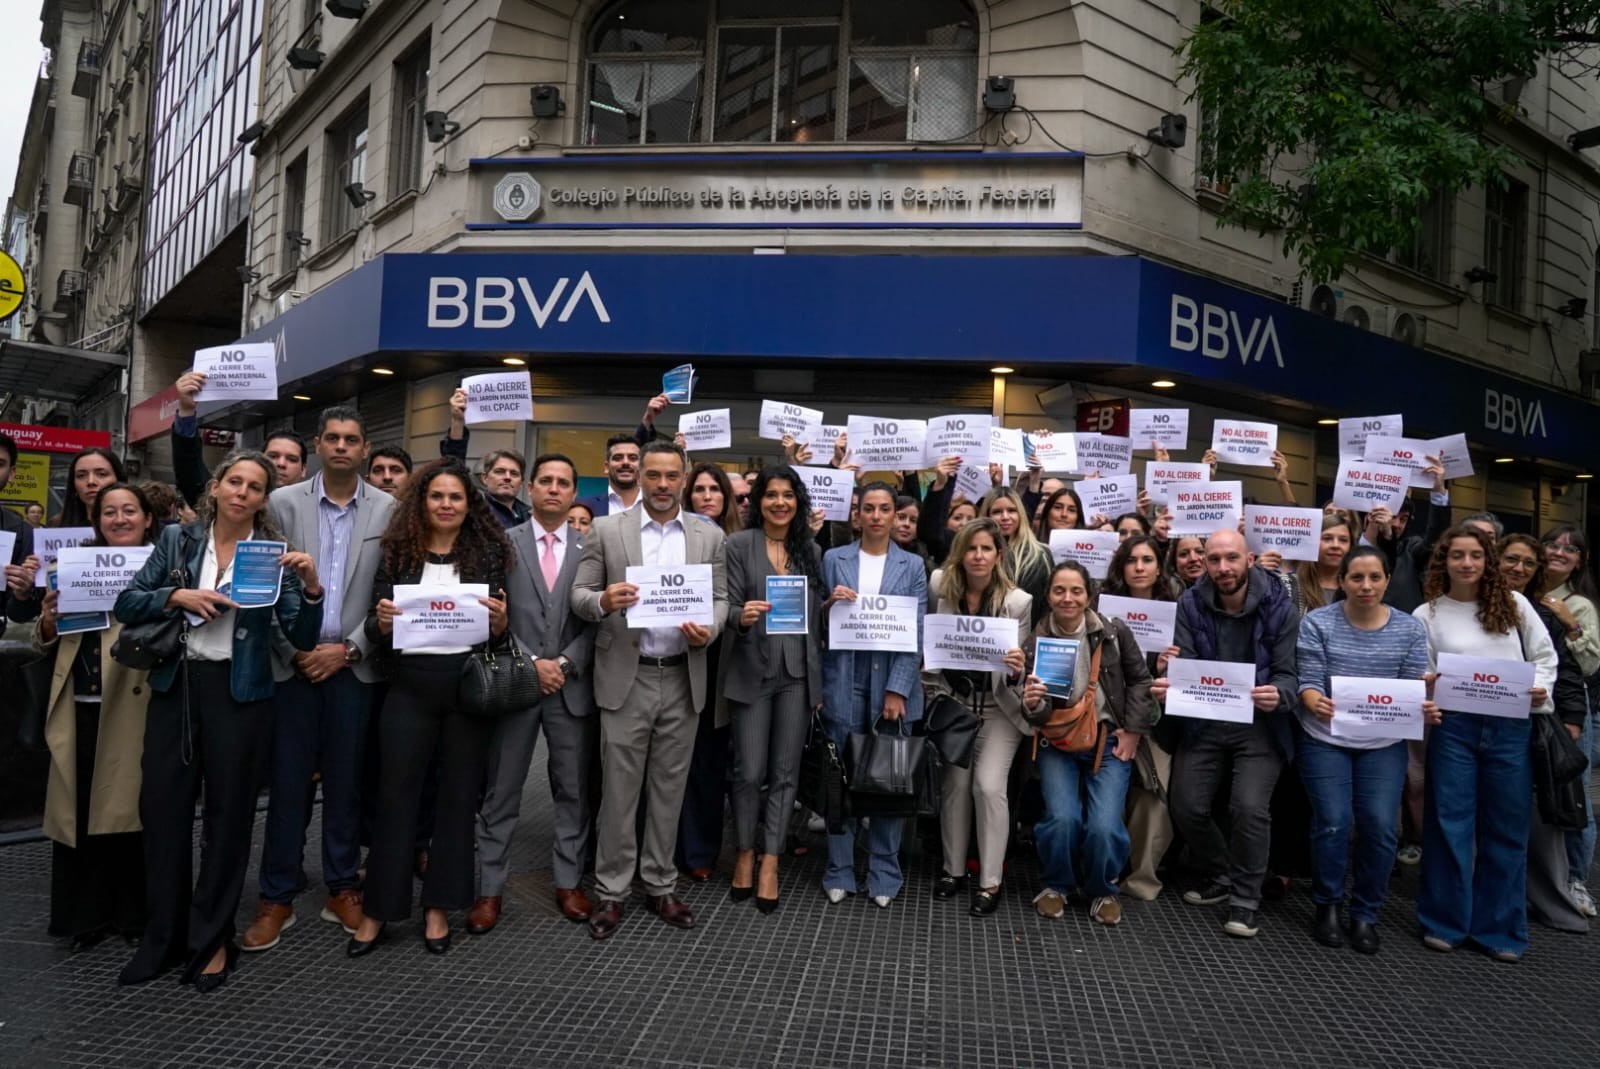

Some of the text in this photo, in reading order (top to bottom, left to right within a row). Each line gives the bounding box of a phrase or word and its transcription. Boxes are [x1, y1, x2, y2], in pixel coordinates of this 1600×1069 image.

[550, 186, 617, 205] Colegio
[623, 185, 693, 204] Público
[700, 186, 722, 203] de
[729, 185, 746, 203] la
[751, 184, 843, 204] Abogacía
[848, 185, 872, 203] de
[879, 185, 894, 203] la
[427, 270, 611, 329] BBVA
[1170, 293, 1285, 369] BBVA
[221, 350, 246, 362] NO
[469, 381, 528, 394] NO AL CIERRE
[480, 402, 521, 412] DEL CPACF
[783, 405, 802, 417] NO
[1484, 388, 1547, 438] BBVA
[696, 414, 712, 424] NO
[1153, 414, 1170, 424] NO
[873, 422, 899, 436] NO
[945, 419, 966, 432] NO
[1362, 421, 1382, 431] NO
[0, 428, 43, 441] ruguay
[823, 428, 840, 437] NO
[1222, 428, 1268, 439] NO AL CIERRE
[855, 447, 880, 455] JARDÍN
[1079, 441, 1129, 454] NO AL CIERRE
[1238, 446, 1260, 454] CPACF
[1393, 450, 1413, 459] NO
[1096, 460, 1120, 470] CPACF
[963, 466, 979, 480] NO
[1154, 470, 1202, 480] NO AL CIERRE
[1347, 470, 1402, 485] NO AL CIERRE
[813, 475, 833, 487] NO
[1100, 483, 1118, 494] NO
[1374, 484, 1400, 493] MATERNAL
[1177, 491, 1233, 502] NO AL CIERRE
[1352, 490, 1391, 502] DEL CPACF
[1186, 511, 1225, 521] DEL CPACF
[1255, 515, 1312, 528] NO AL CIERRE
[45, 539, 62, 551] NO
[1075, 542, 1094, 551] NO
[1275, 537, 1302, 546] CPACF
[96, 554, 126, 567] NO
[70, 579, 103, 588] JARDÍN
[660, 574, 685, 587] NO
[89, 589, 104, 597] DEL
[430, 601, 456, 611] NO
[642, 597, 667, 605] JARDÍN
[861, 596, 888, 611] NO
[858, 613, 883, 621] CIERRE
[885, 614, 897, 622] DEL
[1126, 612, 1148, 622] NO
[840, 621, 908, 632] JARDÍN MATERNAL
[956, 617, 986, 634] NO
[855, 632, 891, 640] DEL CPACF
[943, 633, 996, 645] AL CIERRE DEL
[934, 642, 1008, 656] JARDÍN MATERNAL
[1200, 676, 1224, 686] NO
[1473, 672, 1500, 684] NO
[1206, 692, 1241, 700] MATERNAL
[1451, 685, 1518, 698] JARDÍN MATERNAL
[1367, 694, 1393, 704] NO
